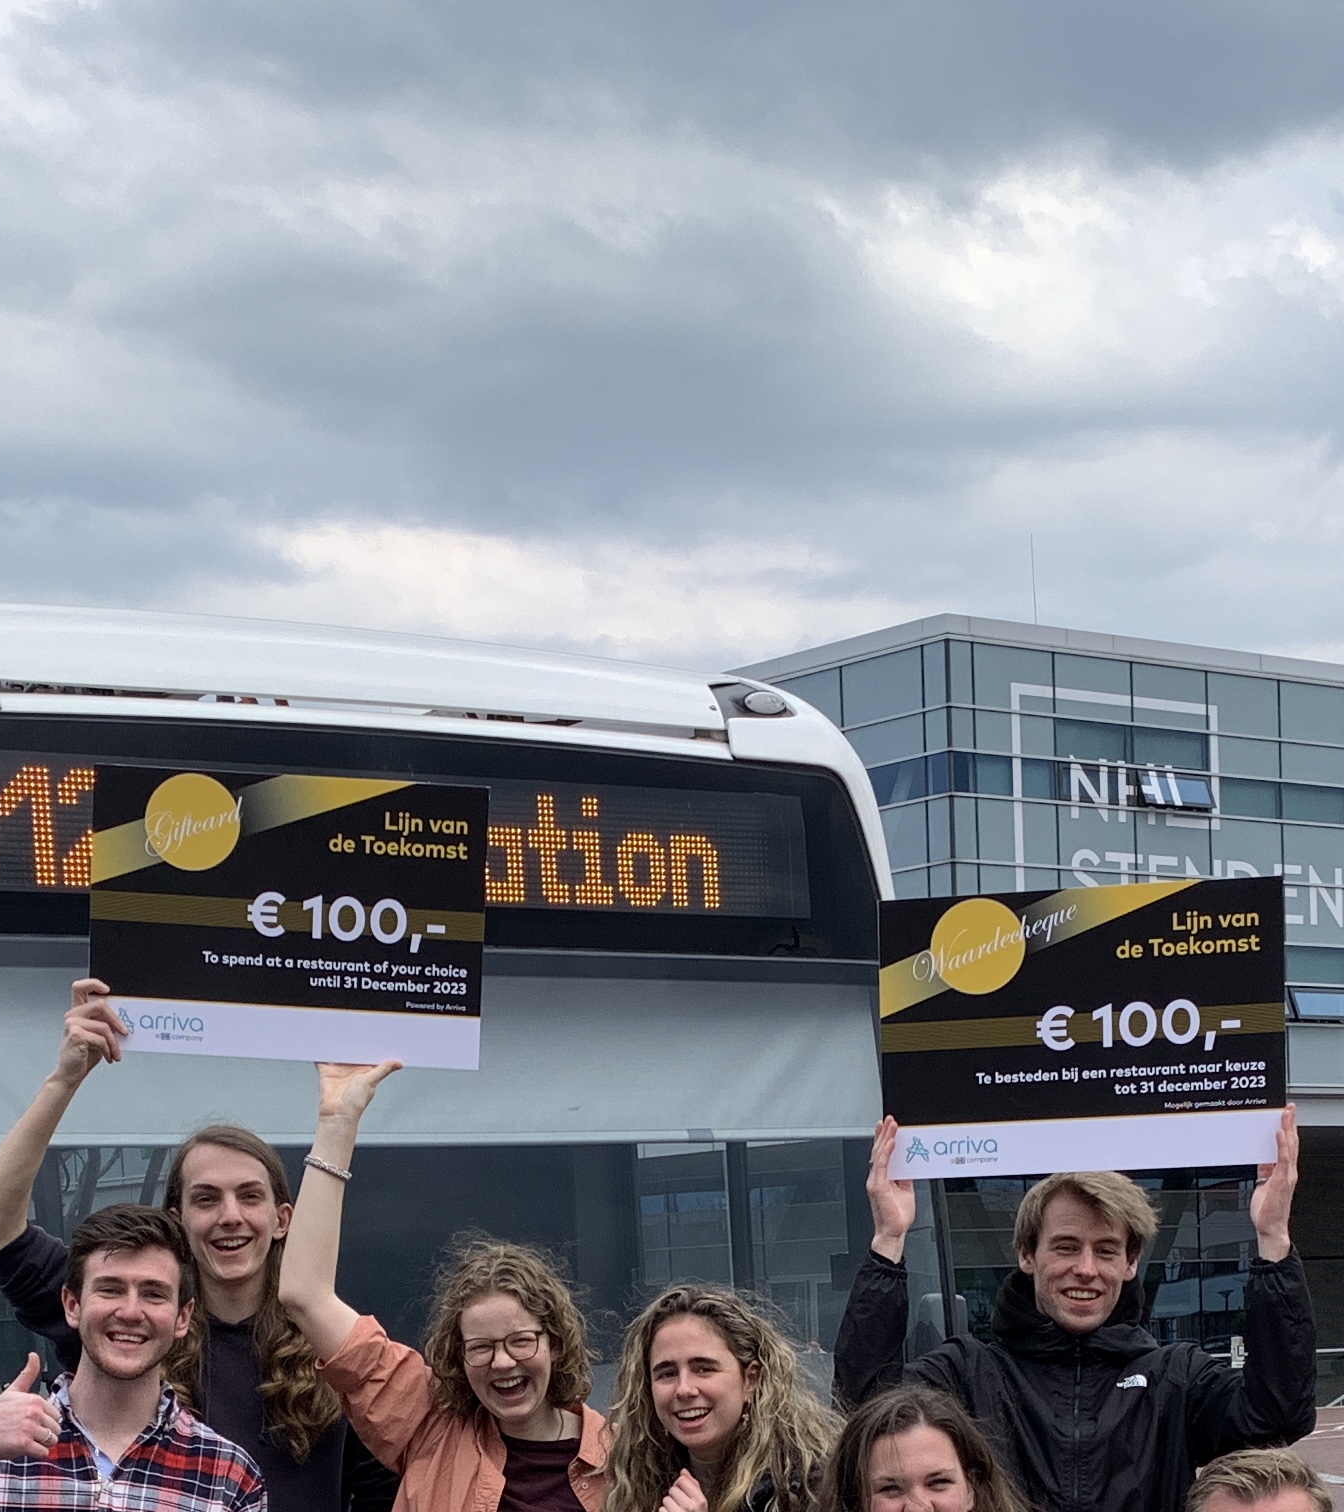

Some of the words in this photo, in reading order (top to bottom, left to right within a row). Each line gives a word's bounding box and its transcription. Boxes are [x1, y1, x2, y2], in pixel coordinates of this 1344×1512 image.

[145, 796, 244, 858] Giftcard
[384, 812, 424, 837] Lijn
[429, 818, 468, 835] van
[329, 833, 356, 852] de
[360, 835, 469, 860] Toekomst
[485, 793, 721, 908] ation
[1071, 848, 1344, 928] STEN
[247, 891, 286, 938] €
[302, 894, 446, 953] 100,-
[1172, 912, 1212, 935] Lijn
[1218, 911, 1259, 929] van
[912, 902, 1077, 983] Waardecheque
[1116, 940, 1143, 960] de
[1148, 935, 1261, 957] Toekomst
[202, 950, 219, 964] To
[221, 952, 263, 967] spend
[266, 955, 282, 968] at
[285, 958, 295, 968] a
[297, 957, 371, 973] restaurant
[373, 960, 389, 973] of
[390, 963, 422, 977] your
[424, 964, 468, 979] choice
[309, 974, 341, 990] until
[343, 976, 358, 989] 31
[361, 977, 431, 993] December
[433, 981, 467, 995] 2023
[139, 1011, 204, 1032] arriva
[1036, 1005, 1076, 1052] €
[1091, 998, 1242, 1052] 100,-
[976, 1072, 992, 1085] Te
[995, 1070, 1058, 1084] besteden
[1061, 1067, 1079, 1083] bij
[1082, 1067, 1107, 1080] een
[1110, 1062, 1186, 1078] restaurant
[1188, 1061, 1222, 1074] naar
[1225, 1058, 1266, 1073] keuze
[1114, 1082, 1137, 1095] tot
[1140, 1081, 1154, 1093] 31
[1158, 1078, 1227, 1093] december
[1230, 1075, 1266, 1089] 2023
[933, 1135, 998, 1156] arriva
